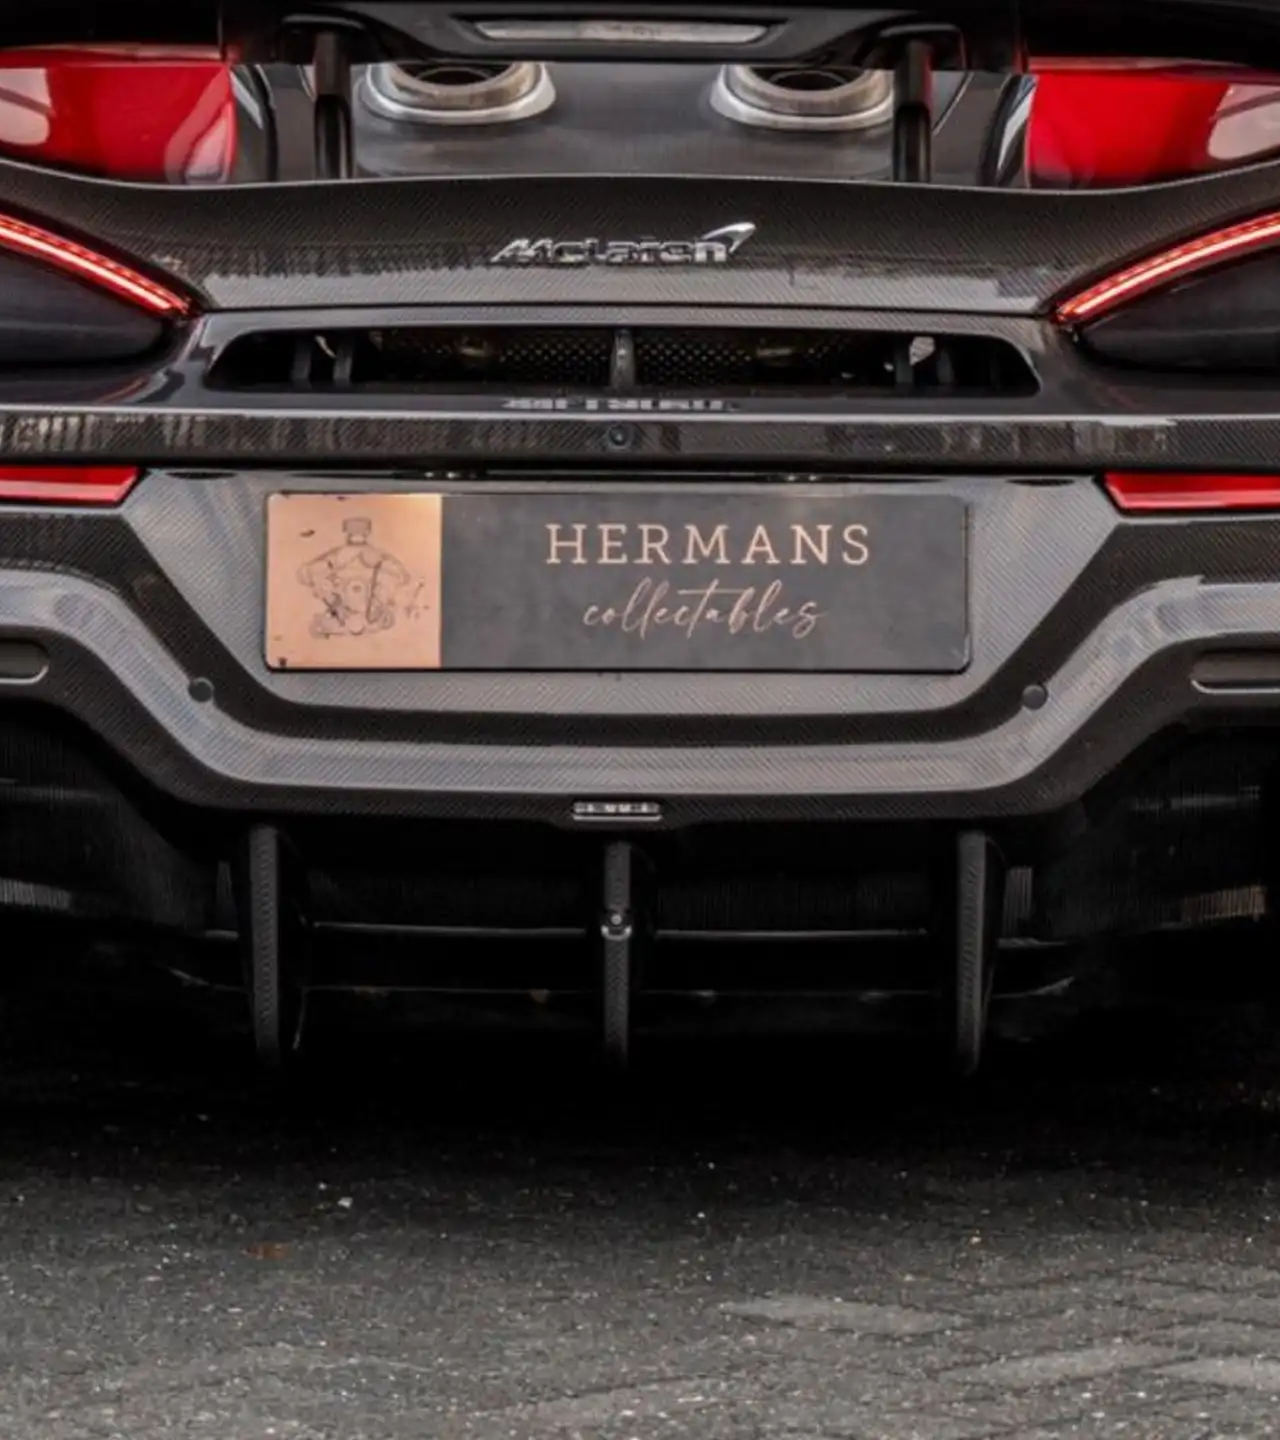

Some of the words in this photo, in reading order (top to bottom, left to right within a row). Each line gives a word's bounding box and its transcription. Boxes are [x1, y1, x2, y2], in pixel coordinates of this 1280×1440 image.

[490, 232, 738, 262] McLaren
[545, 524, 872, 565] HERMANS
[582, 577, 827, 641] collectables
